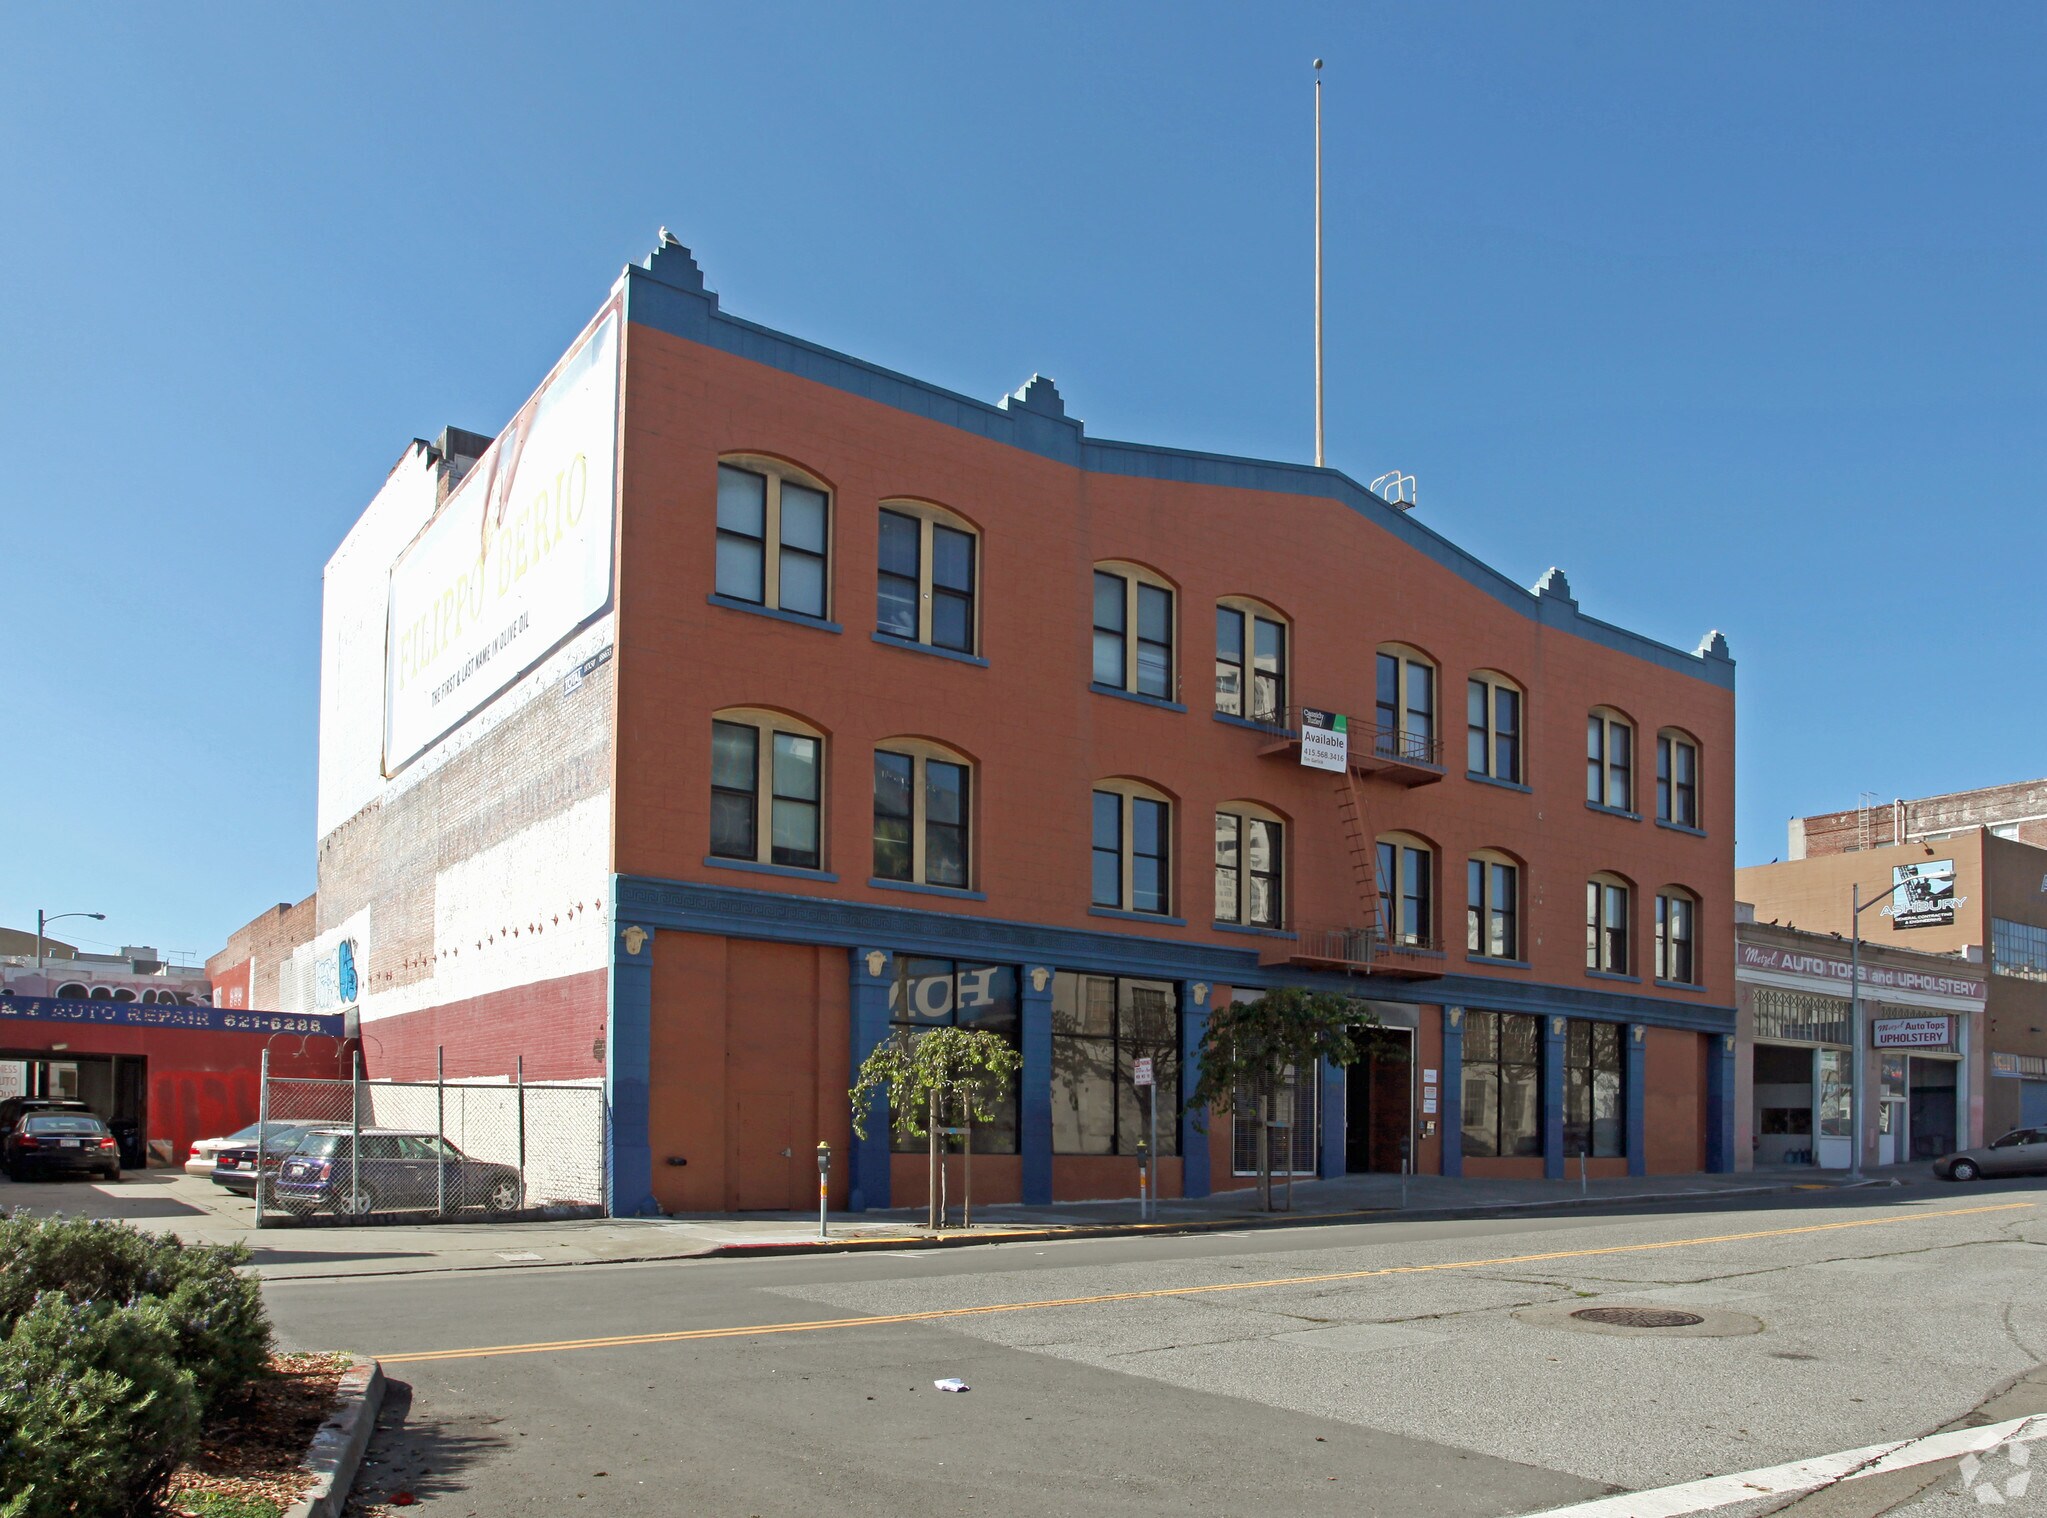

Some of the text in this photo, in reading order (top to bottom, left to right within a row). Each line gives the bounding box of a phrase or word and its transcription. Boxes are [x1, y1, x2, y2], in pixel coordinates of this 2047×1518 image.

[399, 452, 587, 690] FILIPPO BERIO
[431, 687, 441, 707] THE
[441, 673, 456, 699] FIRST
[461, 657, 475, 682] LAST
[475, 643, 491, 670] NAME
[492, 636, 499, 657] IN
[499, 619, 517, 650] OLIVE
[519, 610, 529, 633] OIL
[1304, 731, 1344, 749] Available
[1304, 748, 1344, 762] 415.568.3416
[1880, 896, 1967, 917] ASHBURY
[1781, 953, 1824, 976] AUTO
[1872, 970, 1893, 985] and
[1898, 972, 1977, 996] UPHOLSTERY
[51, 1004, 116, 1020] AUTO
[127, 1008, 210, 1026] REPAIR
[1905, 1022, 1925, 1031] Auto
[1926, 1021, 1946, 1031] Tops
[1880, 1032, 1943, 1044] UPHOLSTERY
